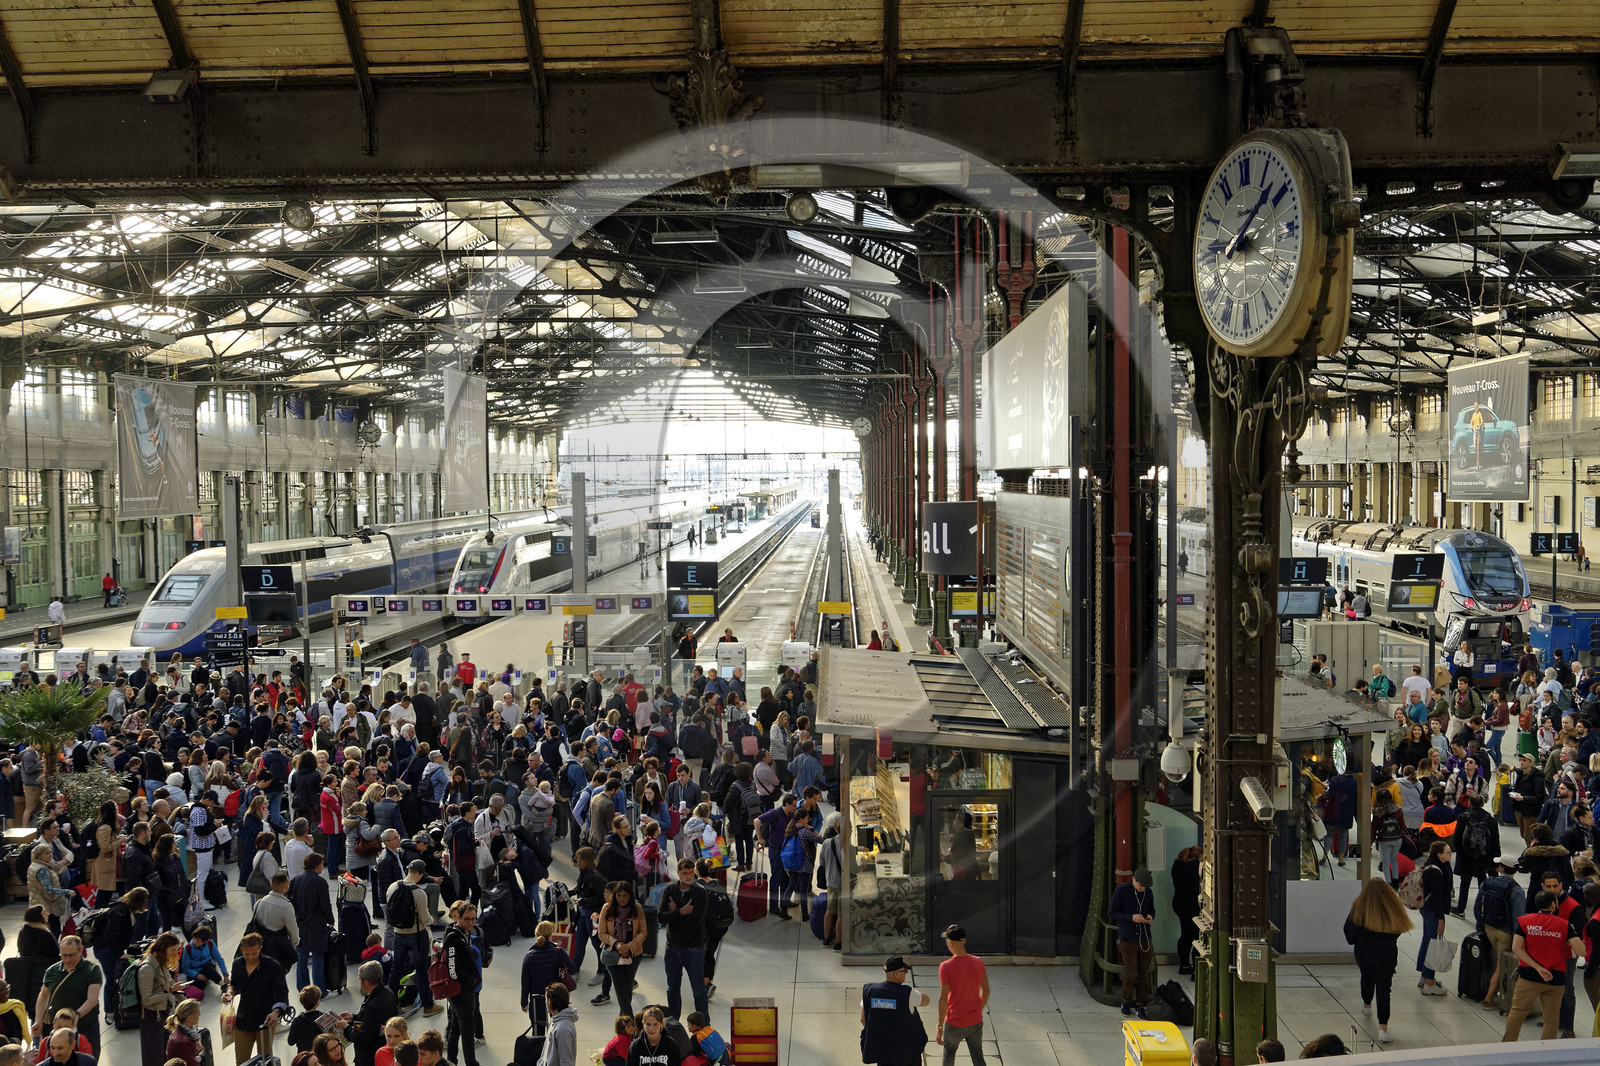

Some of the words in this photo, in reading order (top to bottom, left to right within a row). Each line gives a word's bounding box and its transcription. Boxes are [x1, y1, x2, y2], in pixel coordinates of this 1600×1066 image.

[1452, 384, 1476, 395] Nouveau
[168, 404, 193, 416] Nouveau
[556, 543, 565, 552] D
[1538, 539, 1546, 549] K
[1565, 539, 1572, 549] L
[688, 570, 696, 582] E
[1294, 567, 1306, 578] H
[261, 574, 273, 586] D
[1528, 930, 1562, 938] ASSISTANCE
